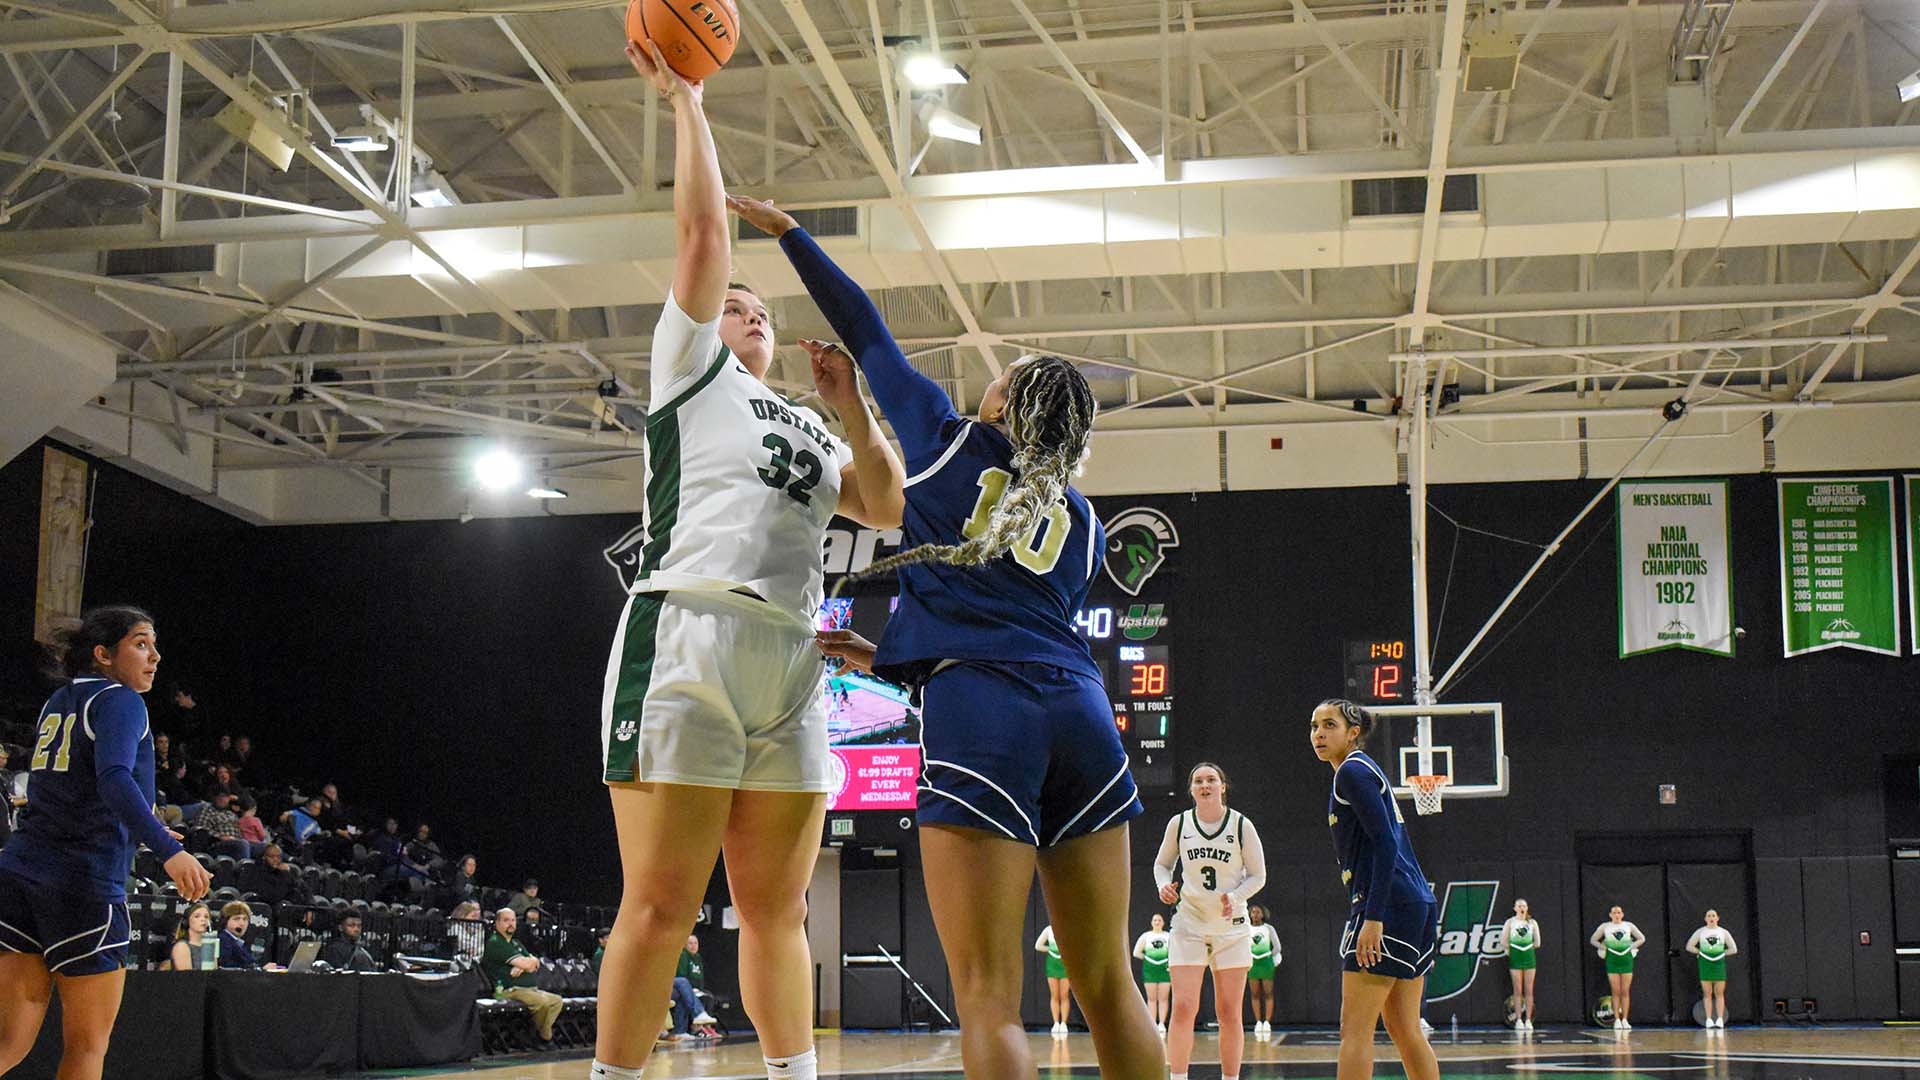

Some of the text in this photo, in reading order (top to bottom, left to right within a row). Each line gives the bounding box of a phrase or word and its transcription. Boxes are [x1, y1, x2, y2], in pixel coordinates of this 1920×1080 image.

[748, 399, 836, 456] UPSTATE
[757, 432, 823, 507] 32
[1813, 484, 1859, 496] CONFERENCE
[1633, 493, 1713, 506] MEN'S BASKETBALL
[1807, 495, 1867, 506] CHAMPIONSHIPS
[962, 466, 1072, 575] 10
[1660, 525, 1687, 542] NAIA
[1648, 542, 1701, 559] NATIONAL
[1642, 559, 1708, 576] CHAMPIONS
[1656, 581, 1695, 604] 1982
[1069, 607, 1112, 638] :40
[1117, 616, 1168, 629] Upstate
[1119, 646, 1145, 661] BUCS
[1371, 641, 1404, 659] 1:40
[1132, 664, 1165, 694] 38
[1373, 665, 1399, 697] 12
[1114, 703, 1127, 712] TOL
[1147, 701, 1172, 711] FOULS
[1116, 716, 1127, 731] 4
[1159, 714, 1167, 736] 1
[31, 712, 77, 772] 21
[1140, 740, 1165, 749] POINTS
[871, 755, 900, 765] ENJOY
[881, 766, 914, 777] DRAFTS
[871, 779, 901, 790] EVERY
[860, 791, 912, 802] WEDNESDAY
[834, 822, 850, 833] EXIT
[1187, 847, 1232, 863] UPSTATE
[1200, 865, 1217, 891] 3
